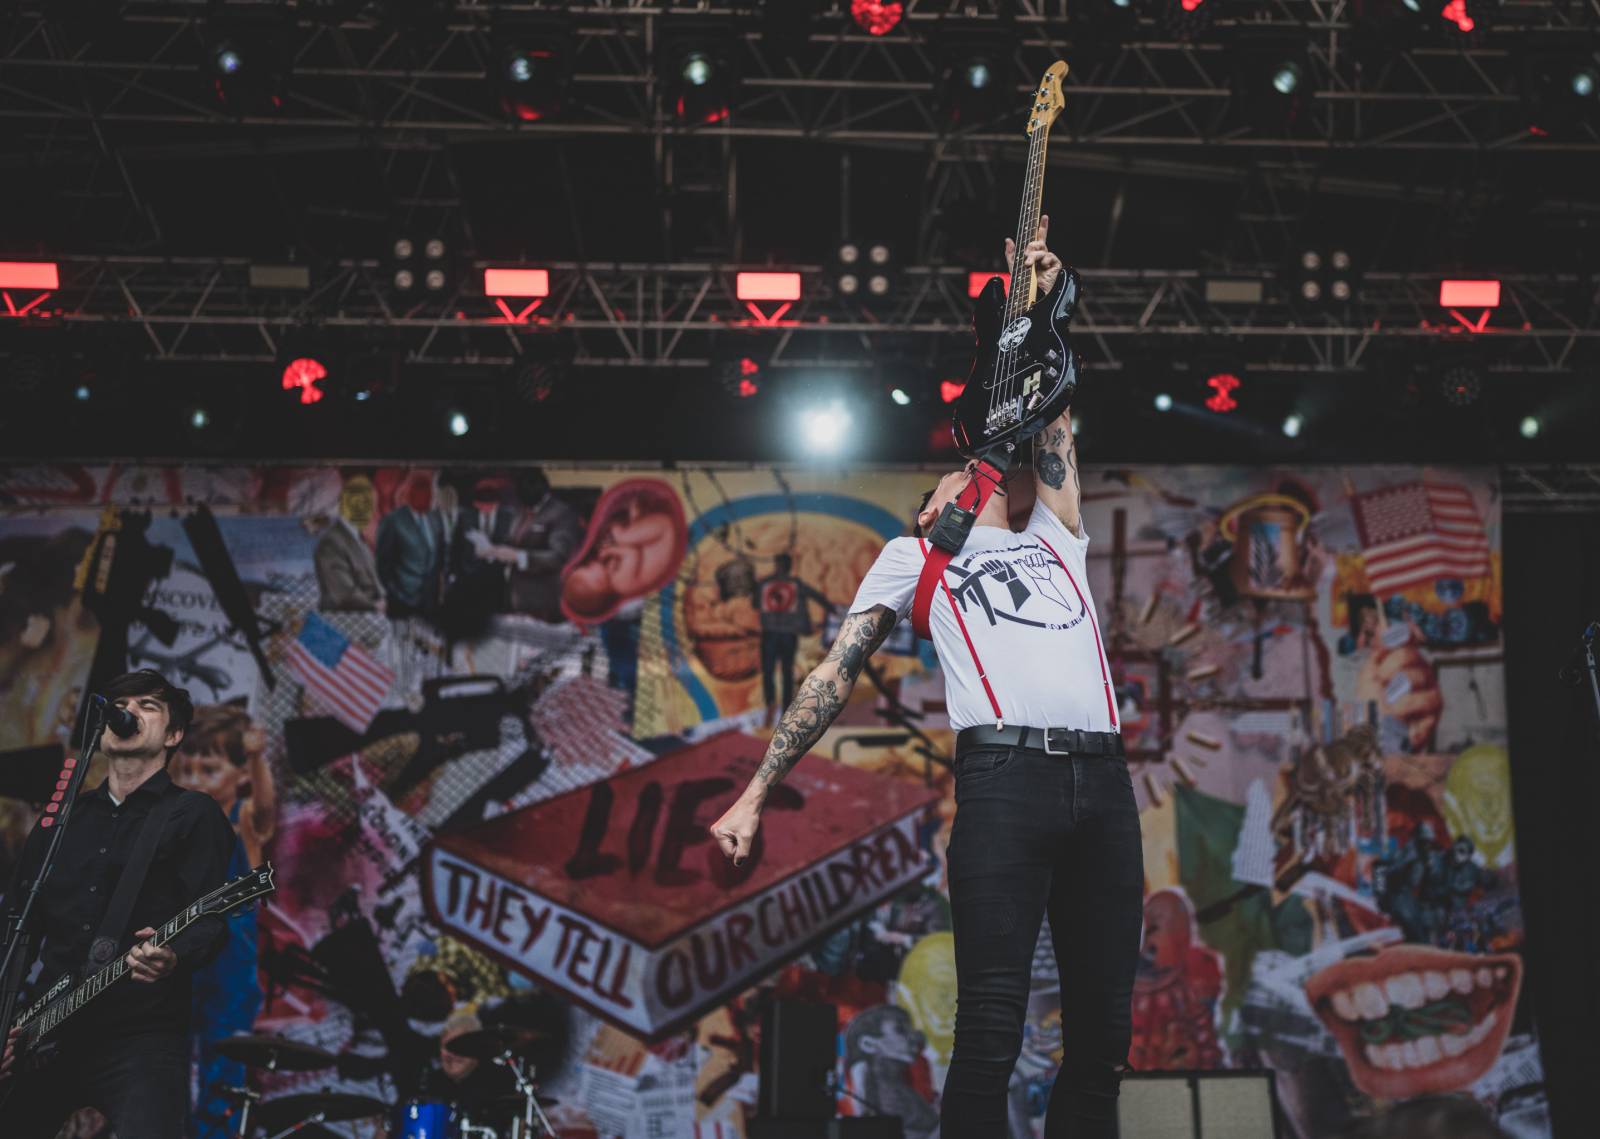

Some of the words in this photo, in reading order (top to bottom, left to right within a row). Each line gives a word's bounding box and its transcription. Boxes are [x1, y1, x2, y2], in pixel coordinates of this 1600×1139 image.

[439, 859, 551, 955] THEY
[554, 914, 634, 1009] TELL
[656, 913, 760, 1009] OUR
[757, 816, 922, 947] CHILDREN
